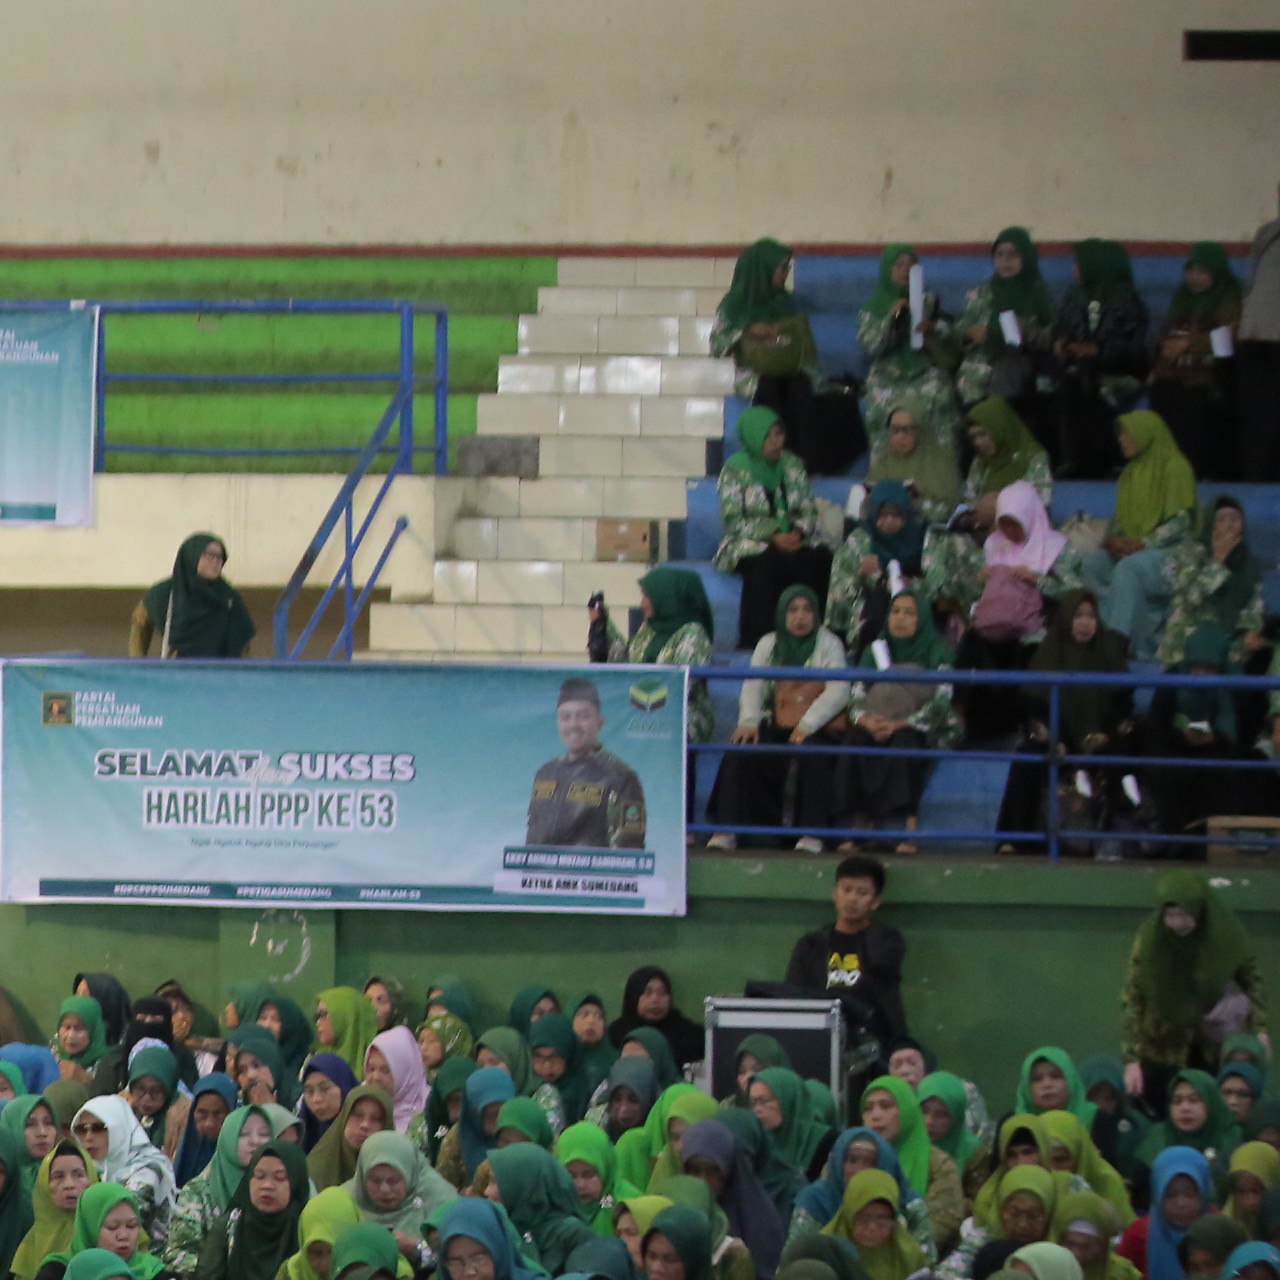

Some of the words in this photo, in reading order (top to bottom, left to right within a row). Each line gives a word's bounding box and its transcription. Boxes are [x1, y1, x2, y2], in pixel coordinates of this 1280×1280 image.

[75, 691, 115, 702] PARTAI
[75, 703, 140, 714] PERSATUAN
[95, 749, 262, 780] SELAMAT
[277, 752, 416, 782] SUKSES
[144, 789, 252, 826] HARLAH
[259, 791, 311, 828] PPP
[316, 792, 353, 829] KE
[358, 792, 395, 829] 53
